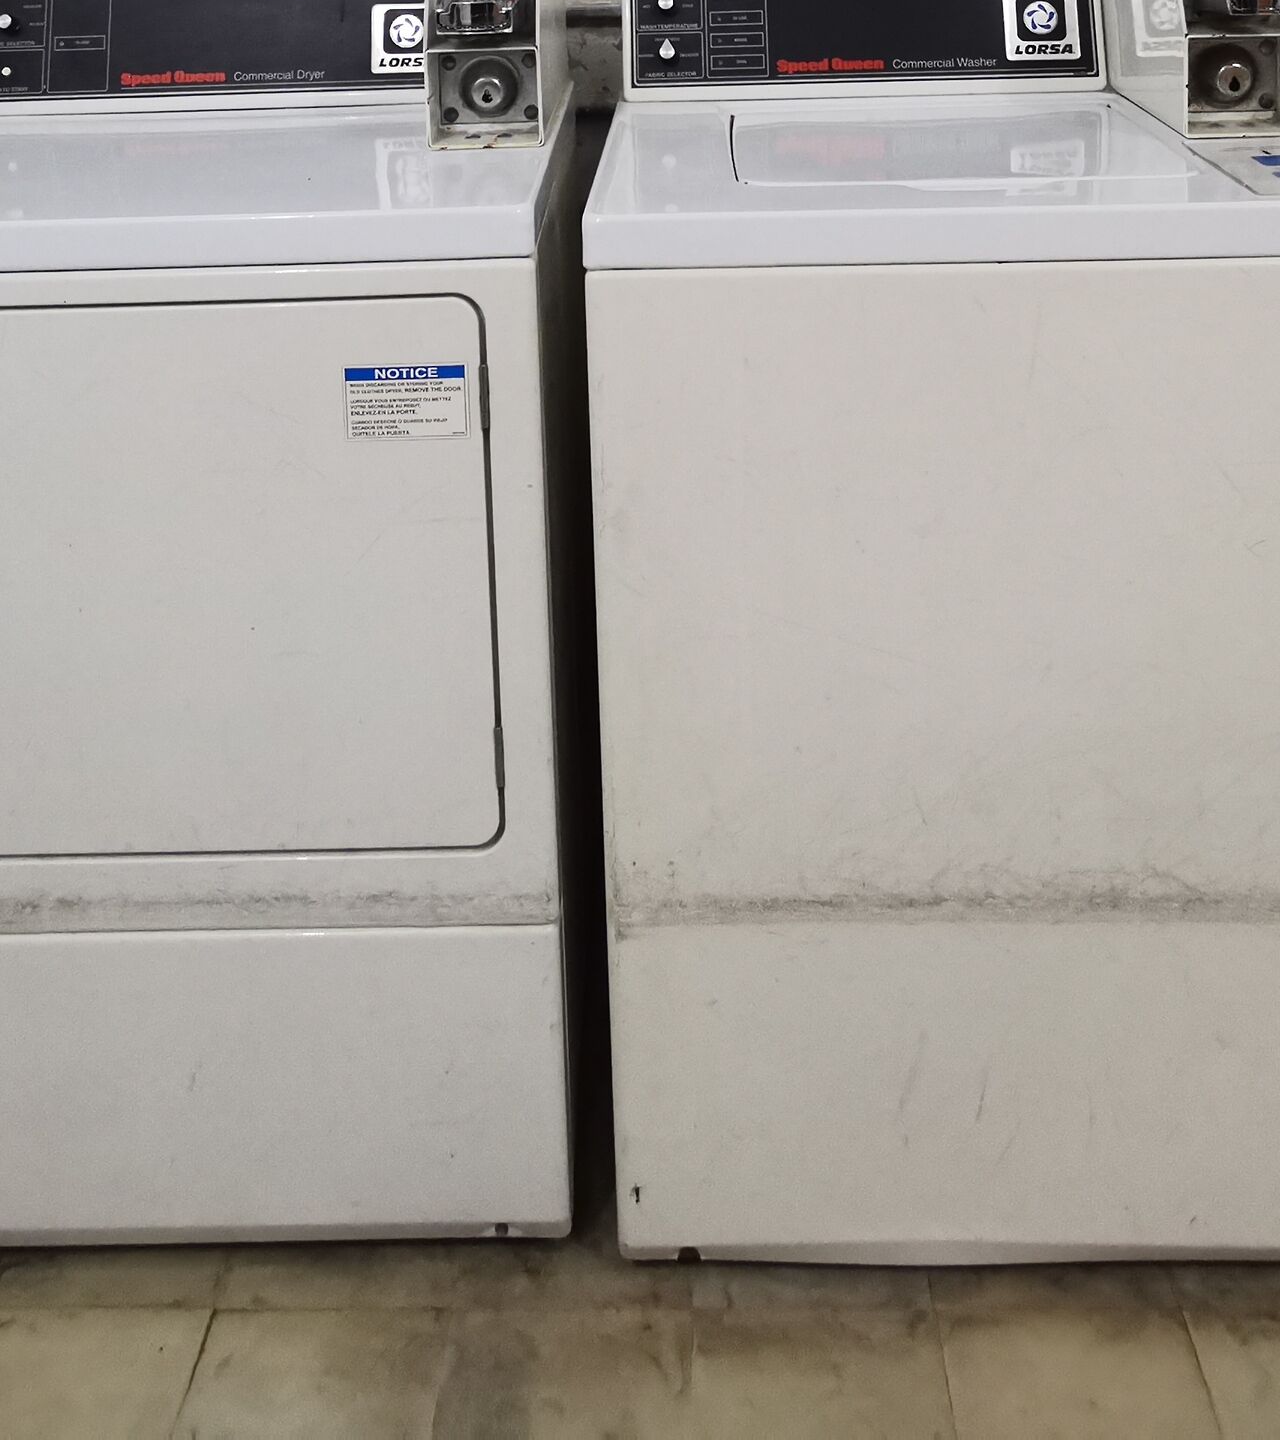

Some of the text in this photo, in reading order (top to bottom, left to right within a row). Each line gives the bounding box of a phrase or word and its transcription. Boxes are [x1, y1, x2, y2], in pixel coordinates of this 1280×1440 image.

[1014, 43, 1074, 55] LORSA
[379, 57, 424, 67] LORS
[777, 56, 997, 74] Speed Queen Commercial Washer
[121, 69, 325, 87] Speed Queen Commercial Dryer
[374, 367, 439, 379] NOTICE
